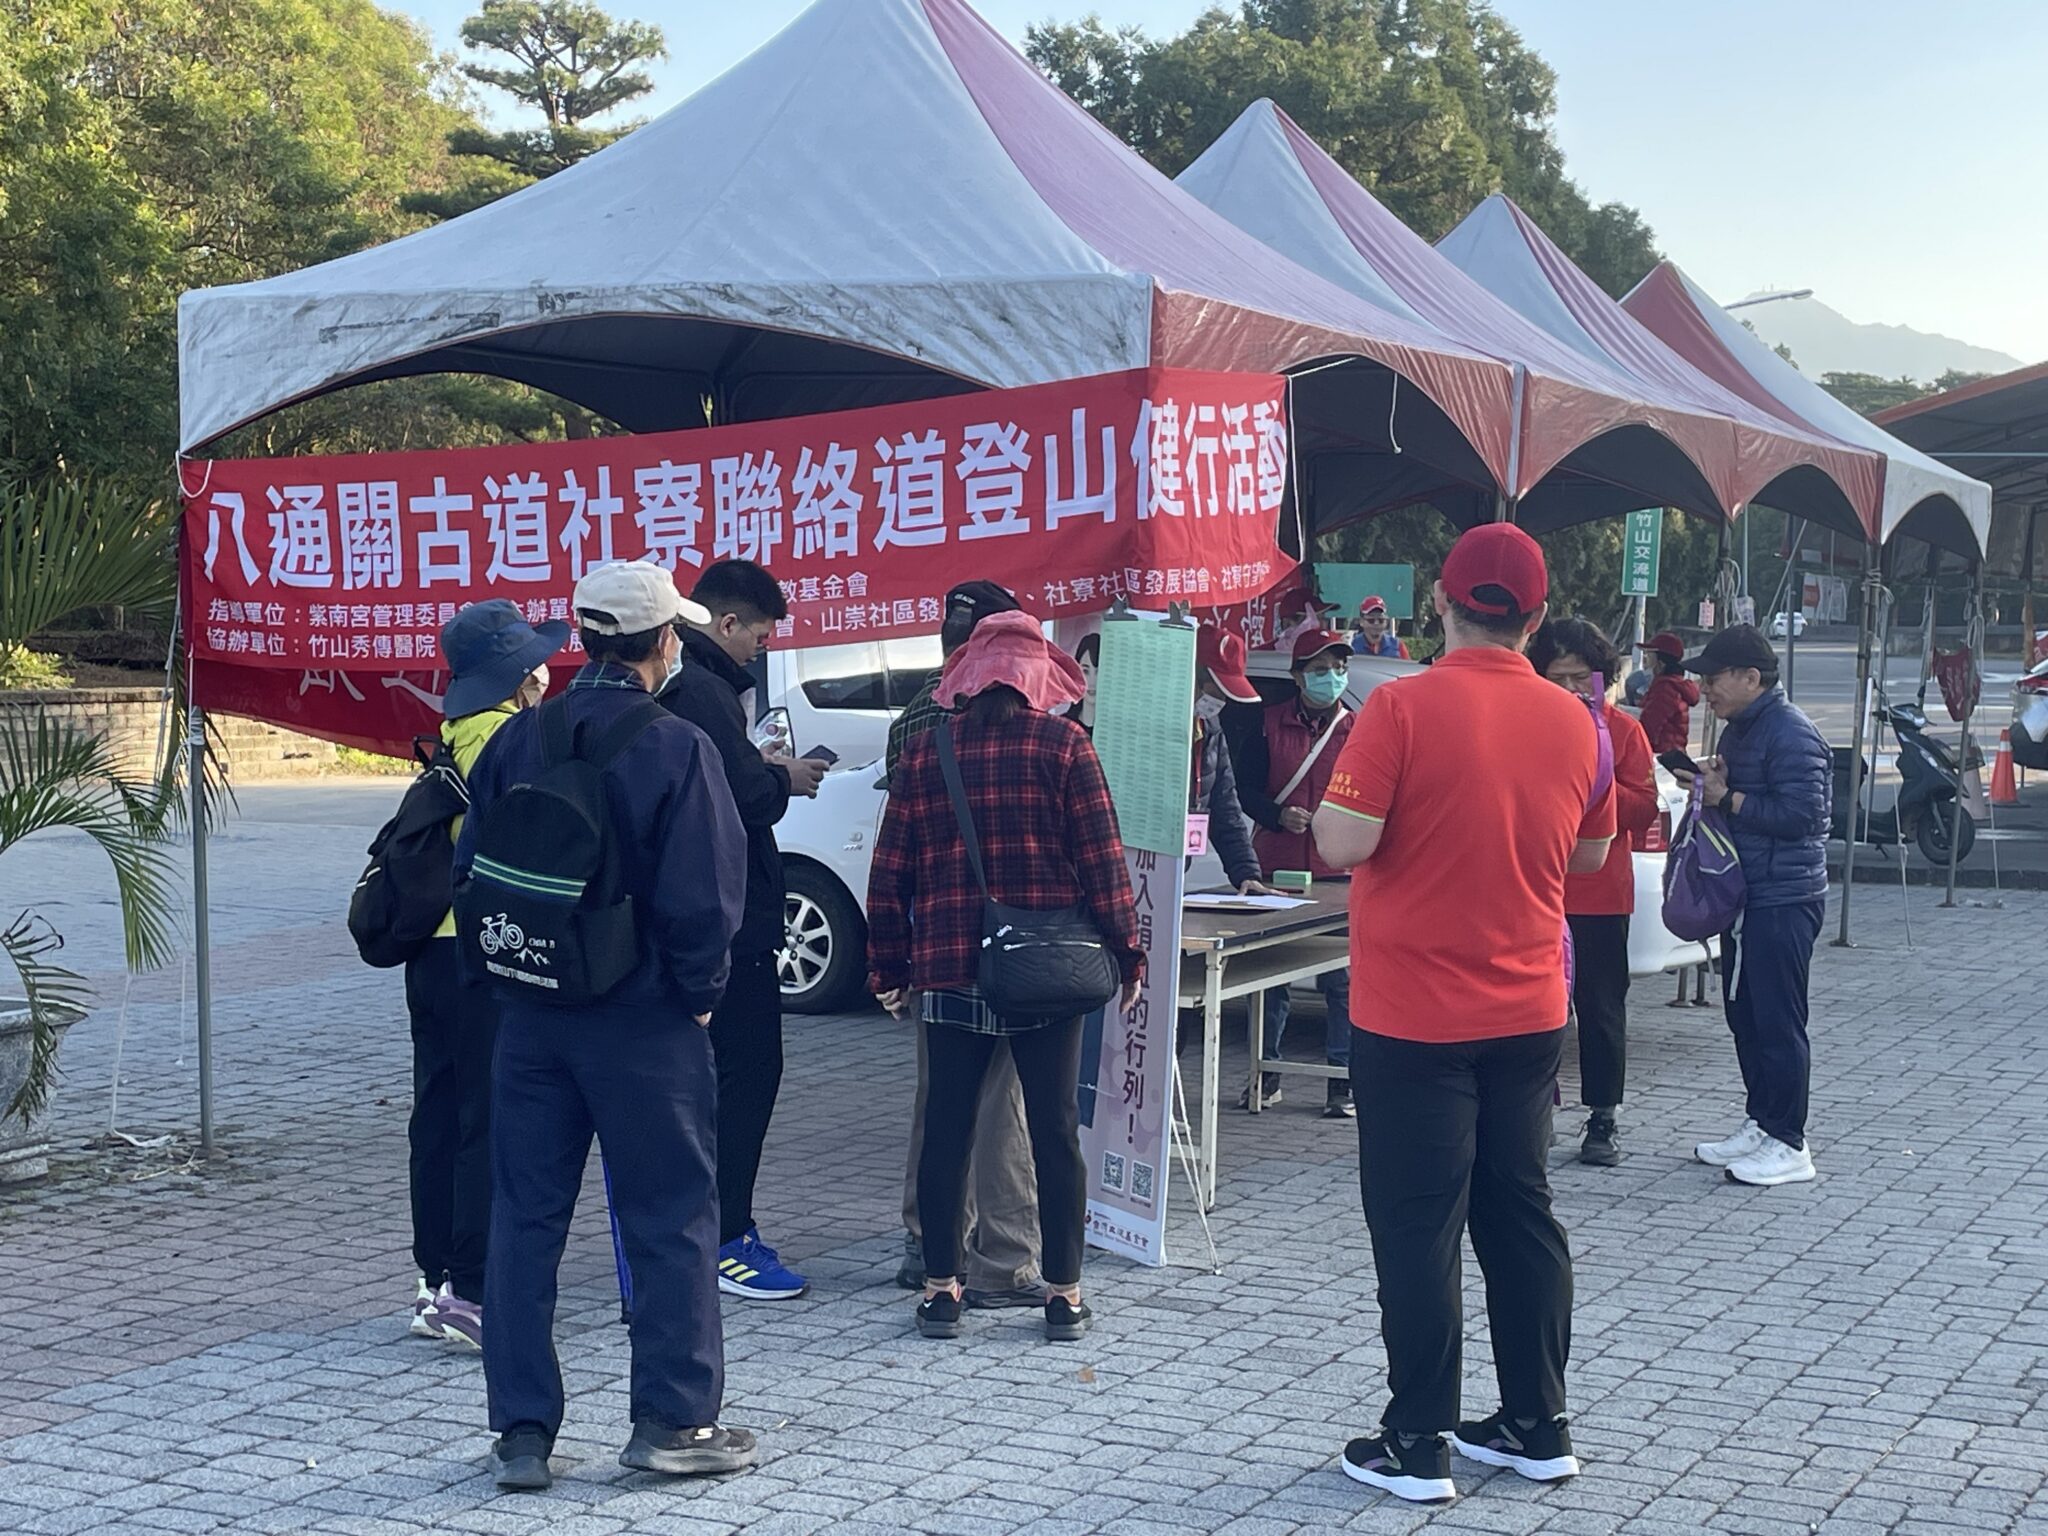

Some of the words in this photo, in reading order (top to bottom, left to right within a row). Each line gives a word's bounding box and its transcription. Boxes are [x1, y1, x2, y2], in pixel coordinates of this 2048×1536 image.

[203, 397, 1287, 592] 八通關古道社寮聯絡道登山健行活動
[207, 597, 475, 629] 指導單位：紫南宮管理委員
